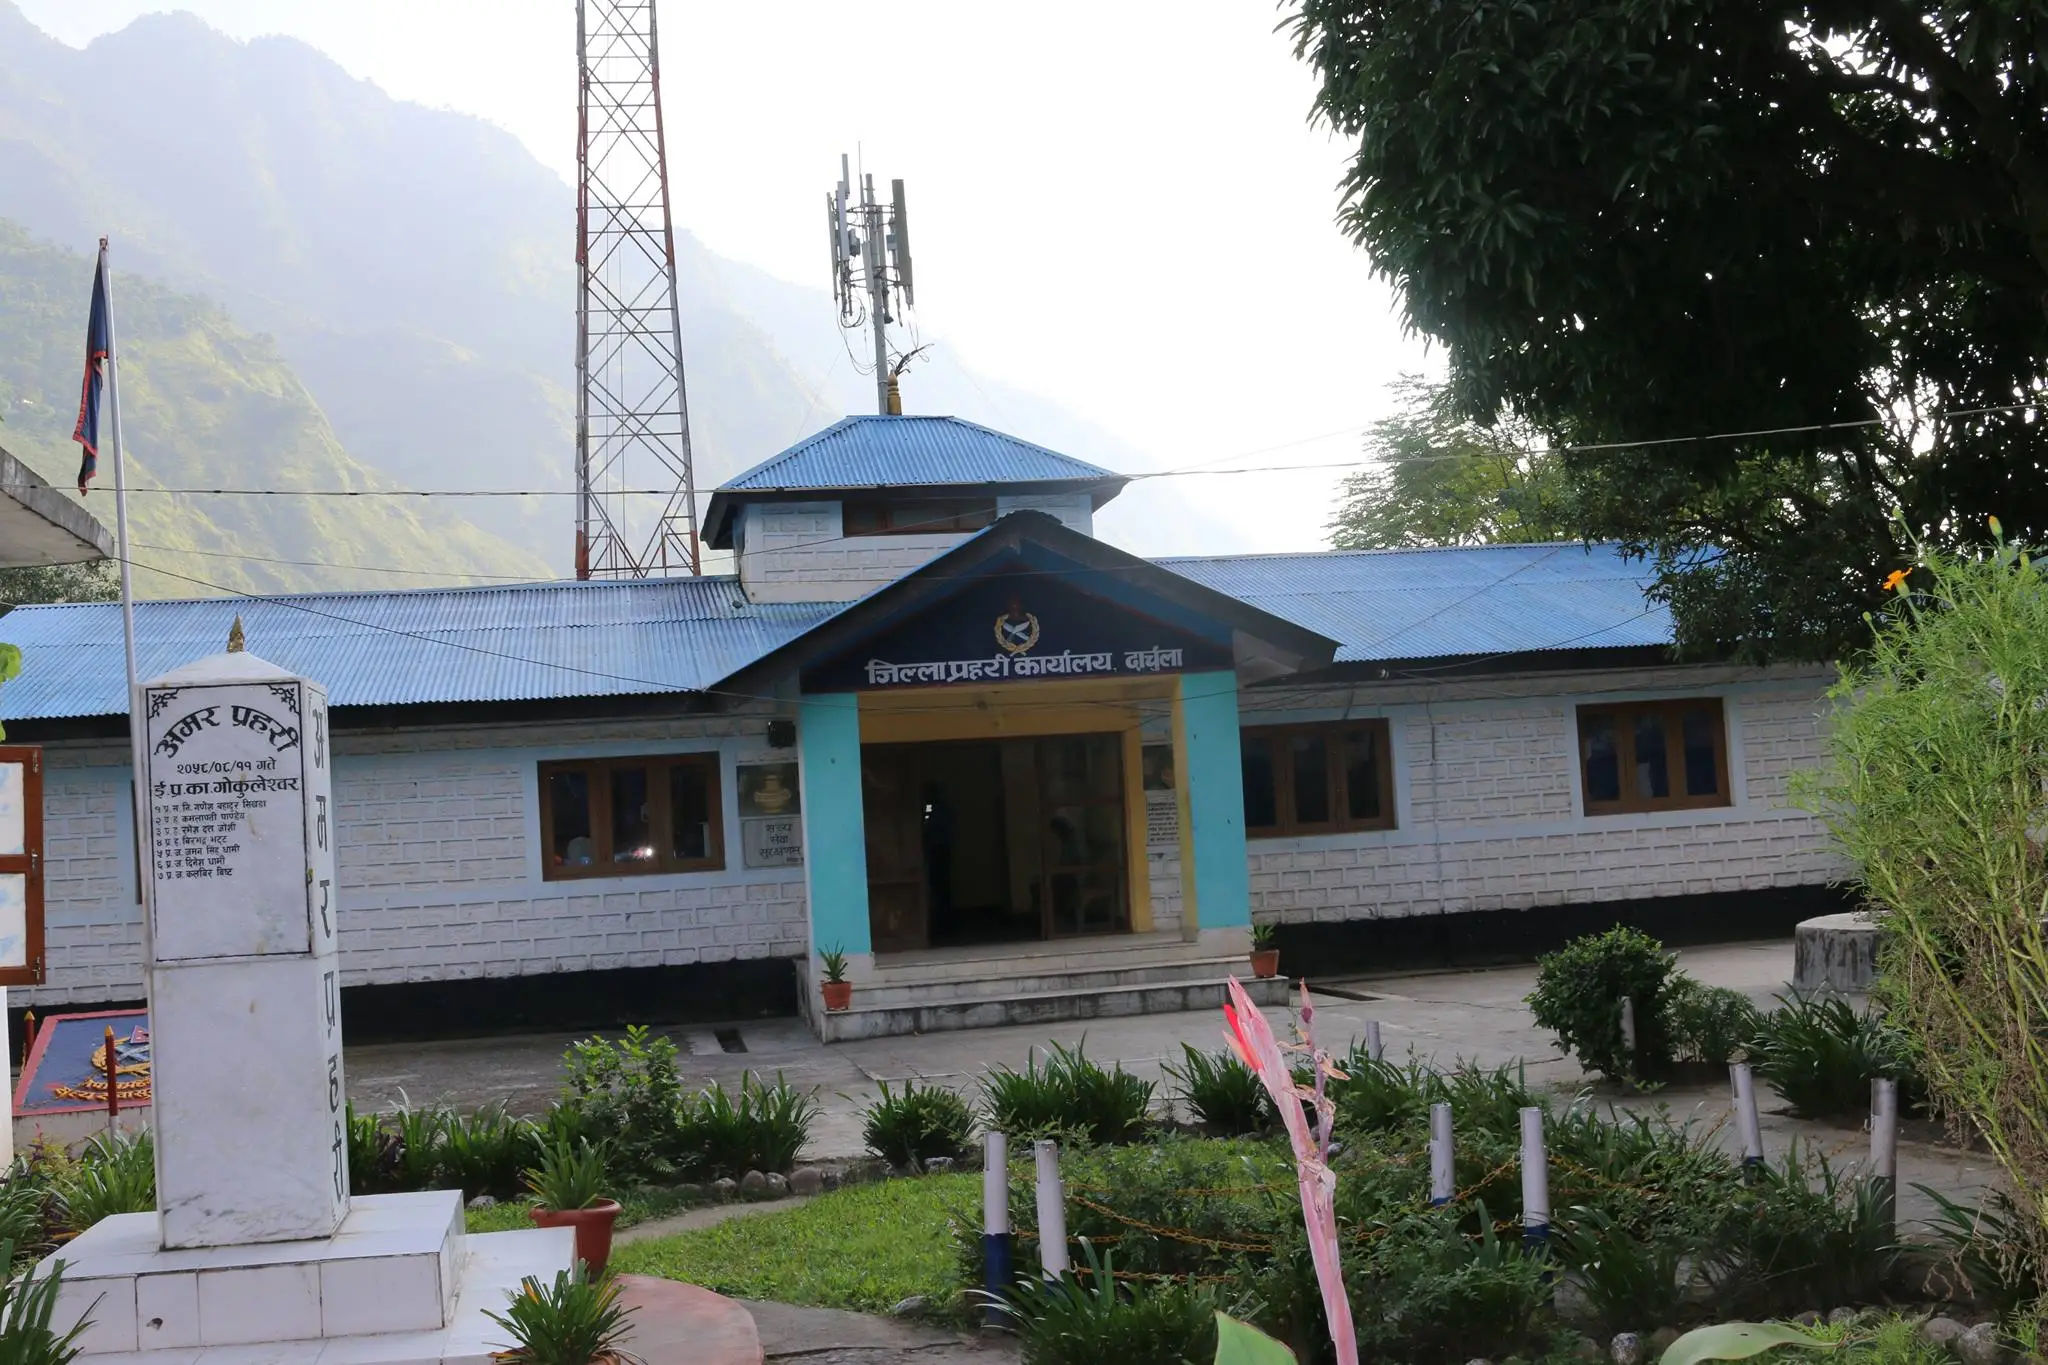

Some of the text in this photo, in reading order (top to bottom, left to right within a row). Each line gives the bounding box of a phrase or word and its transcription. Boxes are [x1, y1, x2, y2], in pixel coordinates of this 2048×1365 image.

[864, 658, 947, 684] जिल्ला
[947, 653, 1010, 682] प्रहरी
[1124, 646, 1183, 672] दार्चुला
[153, 705, 299, 758] अमर प्रहरी
[256, 756, 277, 772] गते
